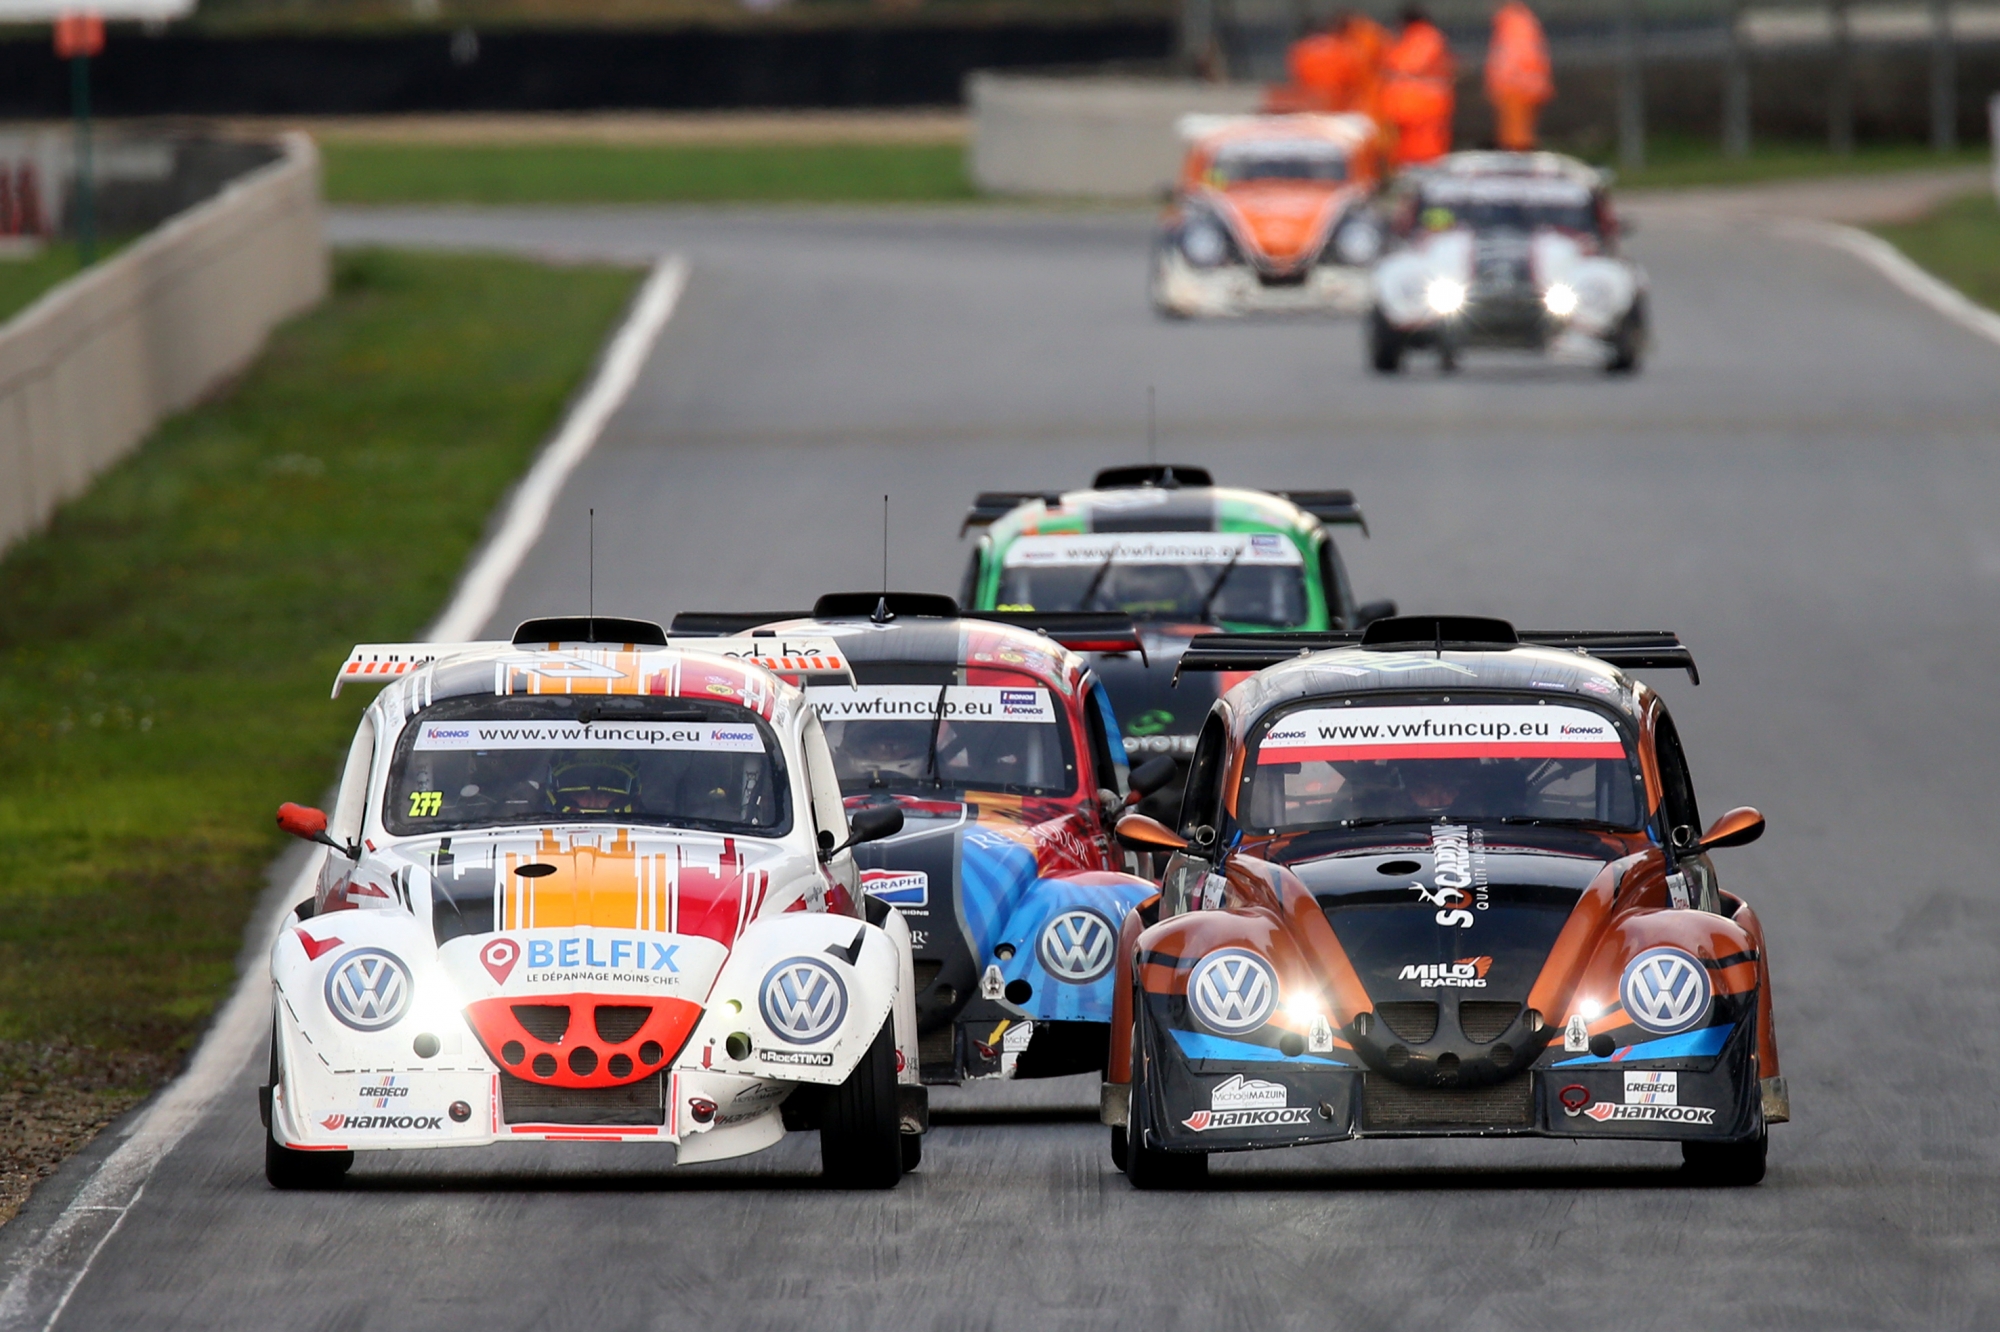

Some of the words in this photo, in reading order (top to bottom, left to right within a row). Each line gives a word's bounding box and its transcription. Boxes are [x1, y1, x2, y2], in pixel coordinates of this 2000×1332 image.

[1003, 704, 1044, 715] KRONOS
[427, 726, 470, 739] KRONOS
[479, 724, 699, 744] www.vwfuncup.eu
[711, 728, 754, 741] KRONOS
[1318, 719, 1549, 740] www.vwfuncup.eu
[1560, 722, 1604, 735] KRONOS
[408, 791, 443, 818] 277
[1474, 866, 1490, 911] QUALITY
[527, 937, 681, 973] BELFIX
[526, 973, 539, 983] LE
[541, 971, 610, 983] DÉPANNAGE
[612, 972, 650, 984] MOINS
[1420, 977, 1487, 989] RACING
[359, 1086, 409, 1097] CREDECO
[1626, 1082, 1676, 1093] CREDECO
